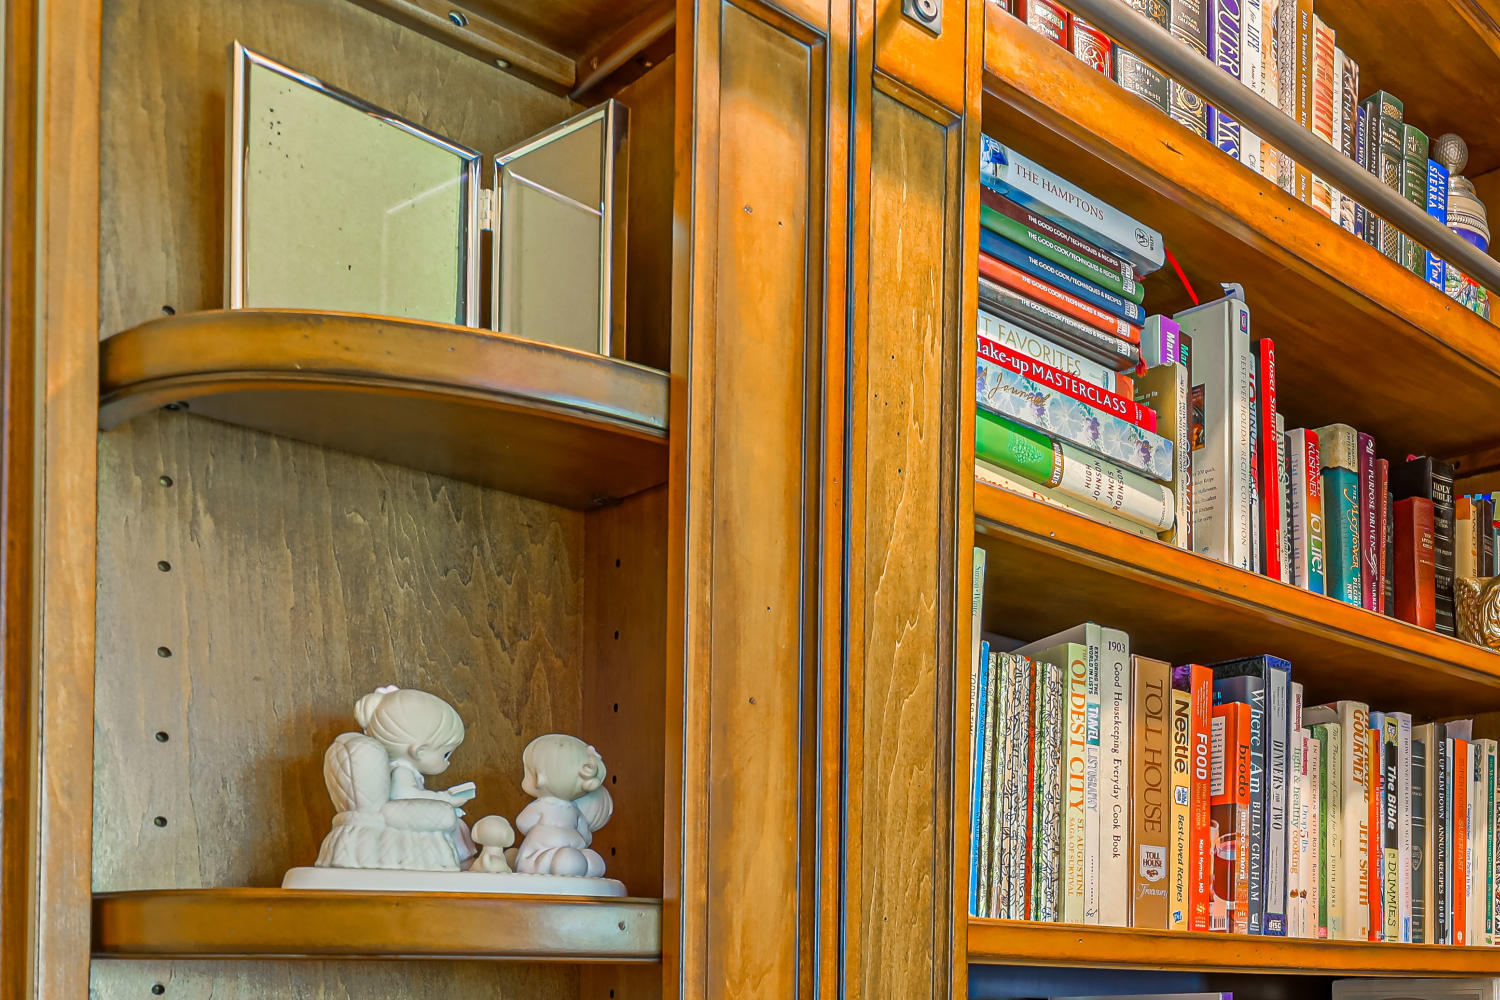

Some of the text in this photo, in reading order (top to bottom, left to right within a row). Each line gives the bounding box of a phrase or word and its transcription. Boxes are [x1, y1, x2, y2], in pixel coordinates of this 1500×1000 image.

[1343, 71, 1351, 158] KATHARINE
[1015, 163, 1105, 220] THE HAMPTONS
[1429, 166, 1437, 208] SIERRA
[1437, 172, 1445, 210] JAVIER
[1027, 231, 1037, 241] THE
[1037, 236, 1053, 249] GOOD
[1103, 269, 1120, 282] RECIPES
[1028, 215, 1037, 224] THE
[1038, 218, 1053, 232] GOOD
[1102, 252, 1118, 266] RECIPES
[1022, 275, 1031, 284] THE
[1032, 280, 1047, 292] GOOD
[1097, 309, 1115, 324] RECIPES
[1029, 256, 1038, 266] THE
[1039, 261, 1055, 274] GOOD
[1104, 293, 1122, 305] RECIPES
[1020, 298, 1030, 307] THE
[1031, 302, 1047, 315] GOOD
[1097, 331, 1114, 345] RECIPES
[997, 323, 1081, 377] FAVORITES
[1085, 463, 1093, 489] HUGH
[1092, 460, 1103, 501] JOHNSON
[1106, 470, 1115, 502] JANCIS
[1112, 468, 1123, 511] ROBINSON
[1308, 441, 1316, 497] KUSHNER
[1433, 482, 1451, 494] HOLY
[1432, 490, 1452, 503] BIBLE
[1108, 641, 1126, 652] 1903
[1086, 706, 1099, 812] TRAVEL LISTOGRAPHY
[1111, 662, 1123, 859] Good Housekeeping Everyday Cook Book
[1144, 680, 1163, 833] TOLL HOUSE
[1238, 745, 1250, 797] brodo
[1353, 709, 1364, 787] GOURMET
[1439, 759, 1445, 769] UP
[1250, 688, 1265, 901] Where I Am BILLY GRAHAM
[1387, 766, 1396, 791] The
[1291, 747, 1301, 874] light & healthy cooking
[1387, 793, 1396, 831] Bible
[1068, 841, 1075, 853] OF
[1075, 835, 1084, 897] AUGUSTINE
[1176, 814, 1185, 902] Best-Loved Recipes
[1199, 882, 1204, 893] MD
[1388, 861, 1397, 927] DUMMIES
